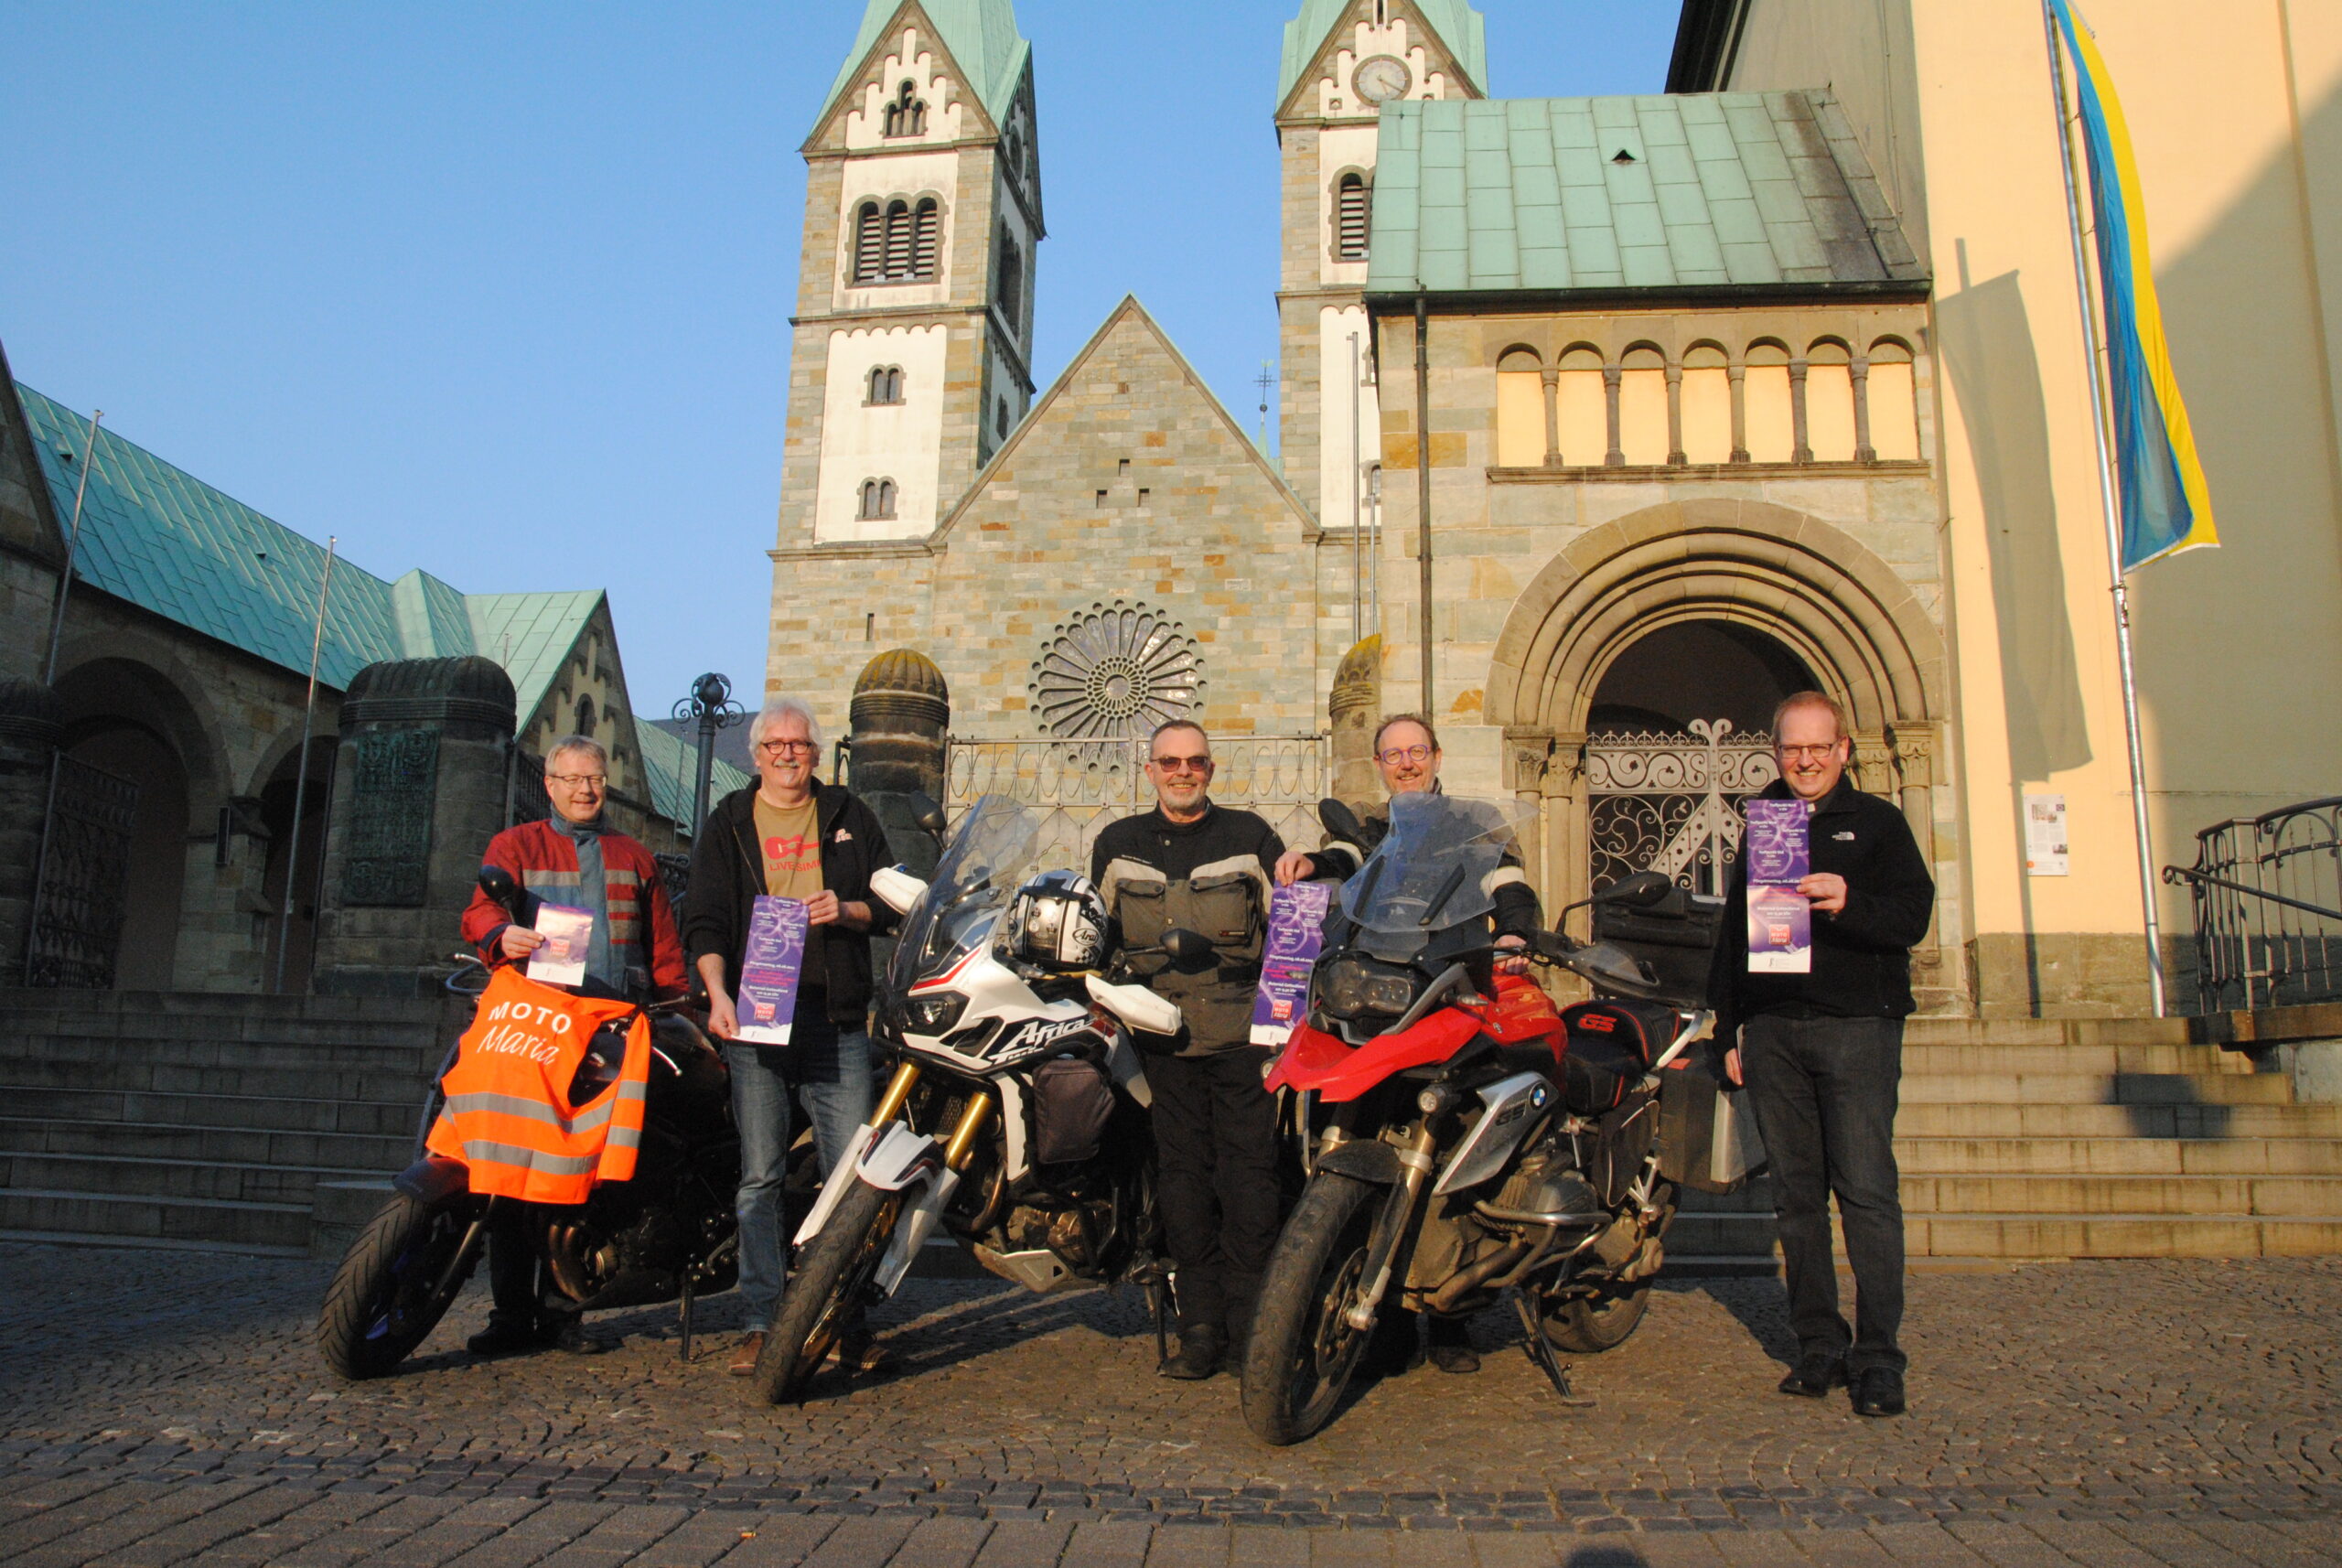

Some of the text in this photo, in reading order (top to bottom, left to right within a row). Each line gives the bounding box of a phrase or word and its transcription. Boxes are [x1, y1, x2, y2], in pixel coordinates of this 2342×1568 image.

[769, 862, 795, 871] LIVE
[1077, 929, 1097, 941] Arai
[488, 1001, 572, 1034] MOTO
[1578, 1014, 1617, 1032] GS
[477, 1024, 560, 1066] Maria
[998, 1019, 1093, 1053] Africa
